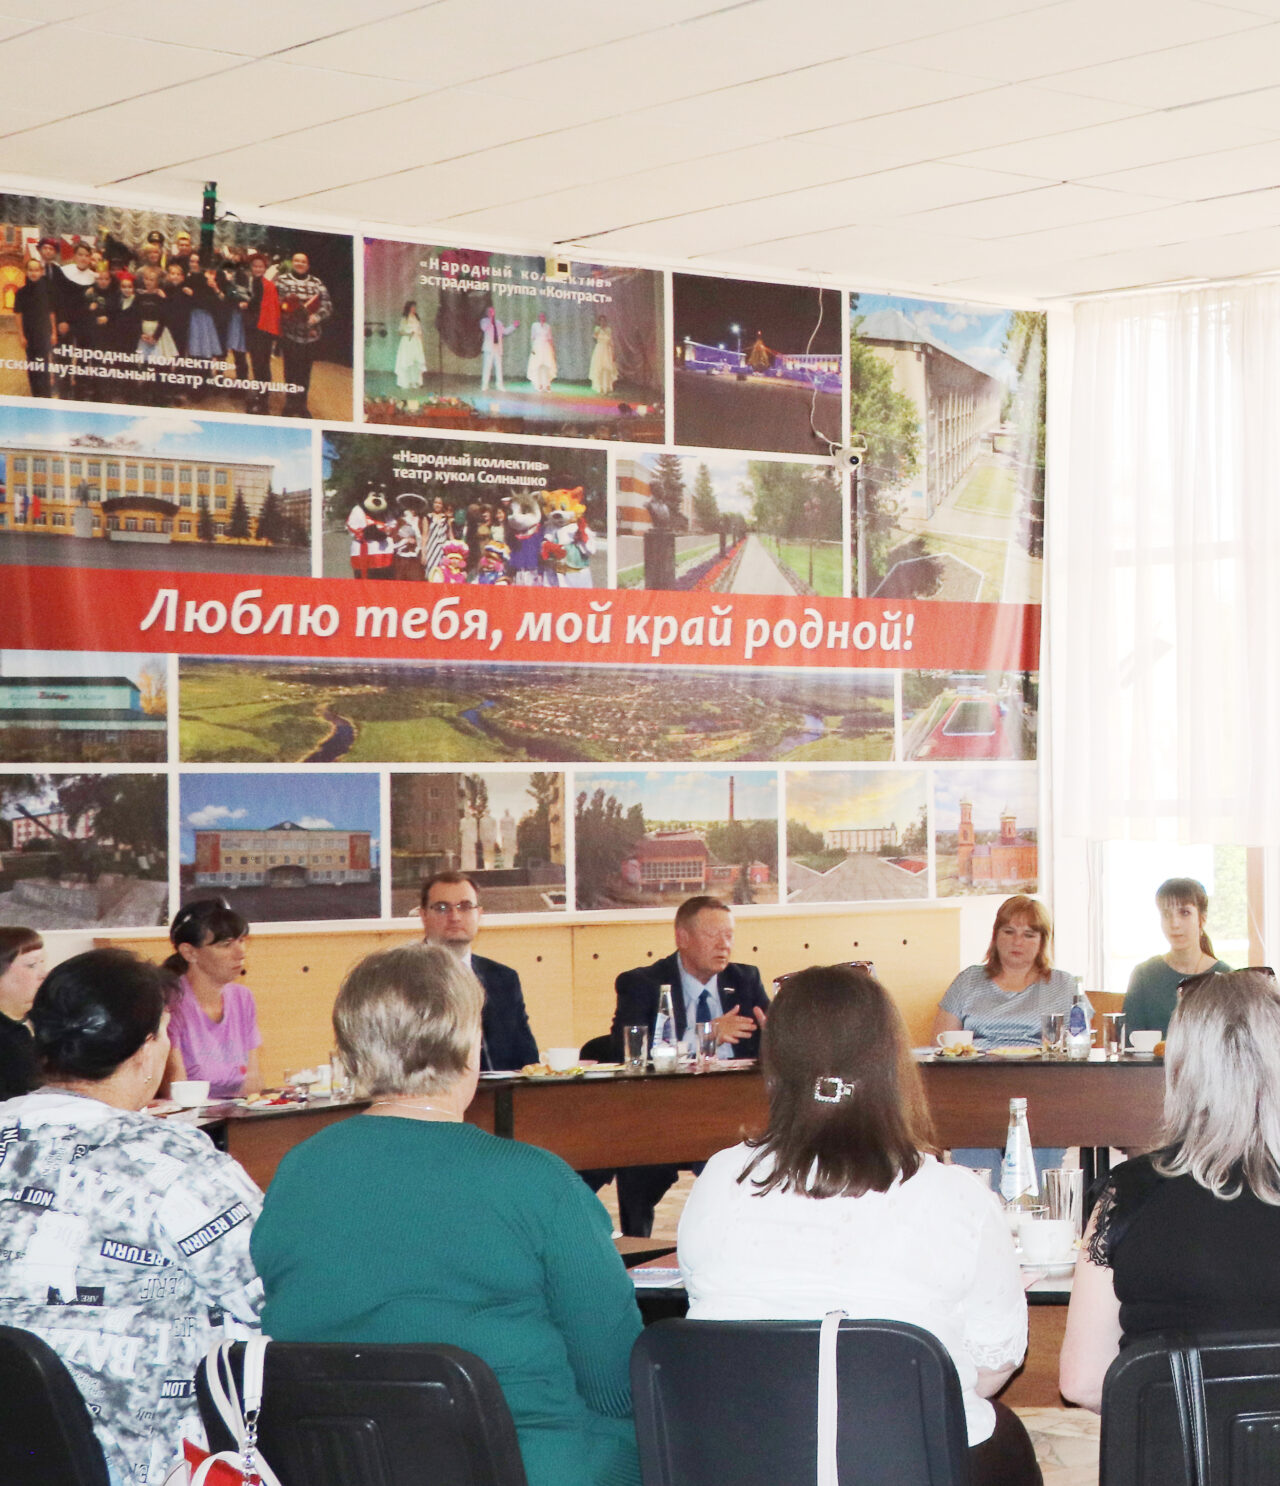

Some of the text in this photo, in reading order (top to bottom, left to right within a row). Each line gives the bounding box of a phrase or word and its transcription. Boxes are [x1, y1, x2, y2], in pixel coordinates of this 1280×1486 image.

[420, 258, 512, 280] «Народный
[419, 275, 612, 304] эстрадная группа «Контраст»
[53, 344, 236, 372] «Народный коллектив»
[48, 363, 156, 382] музыкальный
[159, 371, 203, 389] театр
[206, 374, 305, 394] «Соловушка»
[392, 450, 550, 471] «Народный коллектив»
[392, 467, 547, 487] театр кукол Солнышко
[140, 588, 915, 659] Люблю тебя, мой край родной!
[180, 1202, 251, 1255] NOT RETURN
[103, 1240, 165, 1266] RETURN
[161, 1382, 187, 1397] NOT
